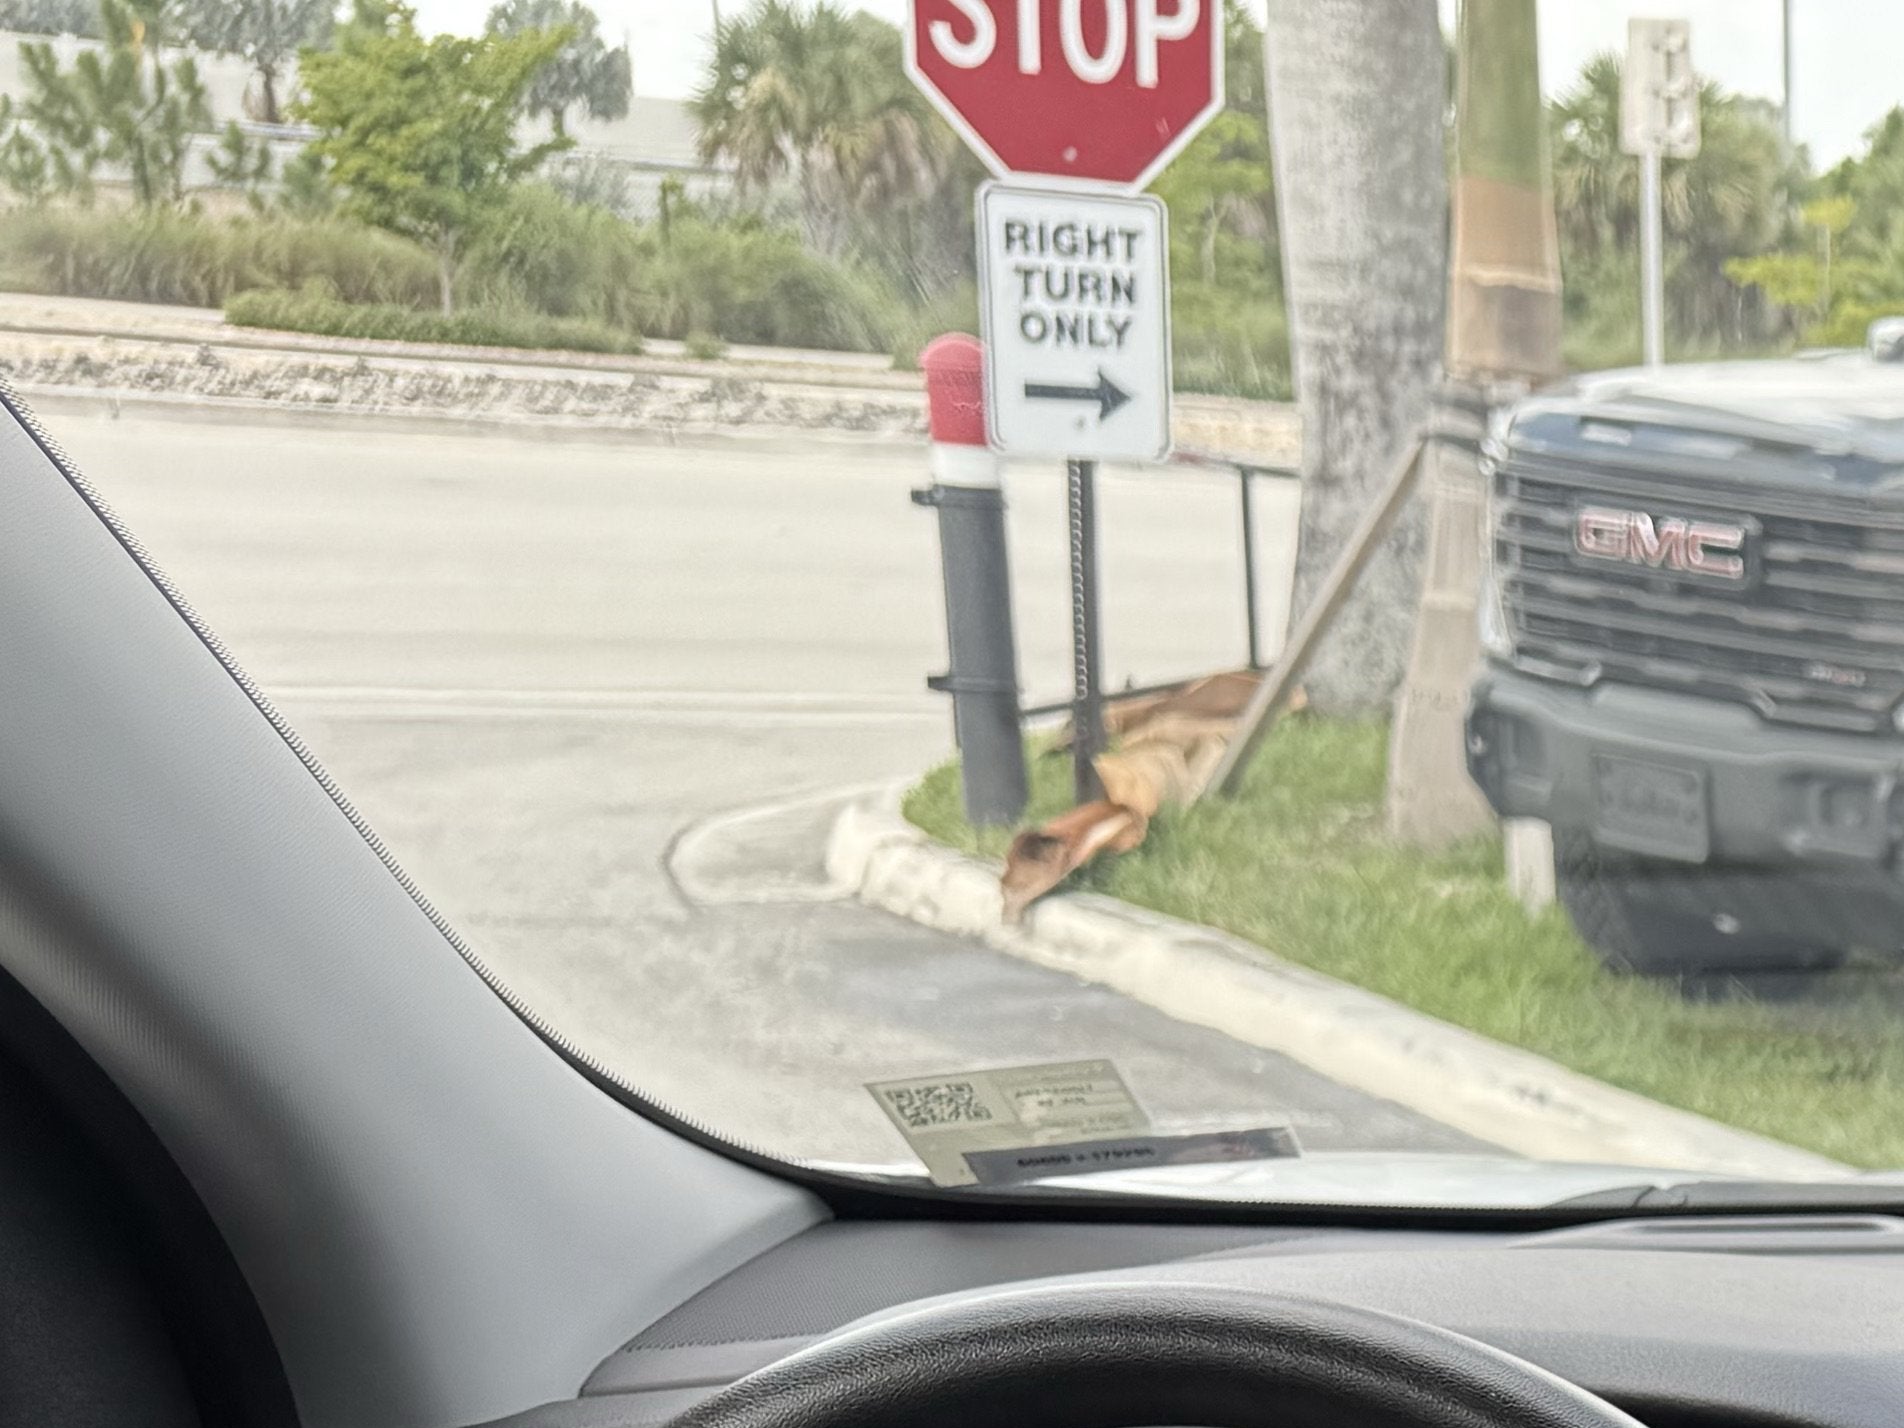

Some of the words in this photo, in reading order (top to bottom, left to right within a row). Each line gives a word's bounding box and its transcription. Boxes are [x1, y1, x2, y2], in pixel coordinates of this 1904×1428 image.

[929, 0, 1199, 89] STOP
[1004, 220, 1142, 261] RIGHT
[1014, 265, 1137, 304] TURN
[1020, 312, 1132, 348] ONLY
[1575, 506, 1746, 579] GMC
